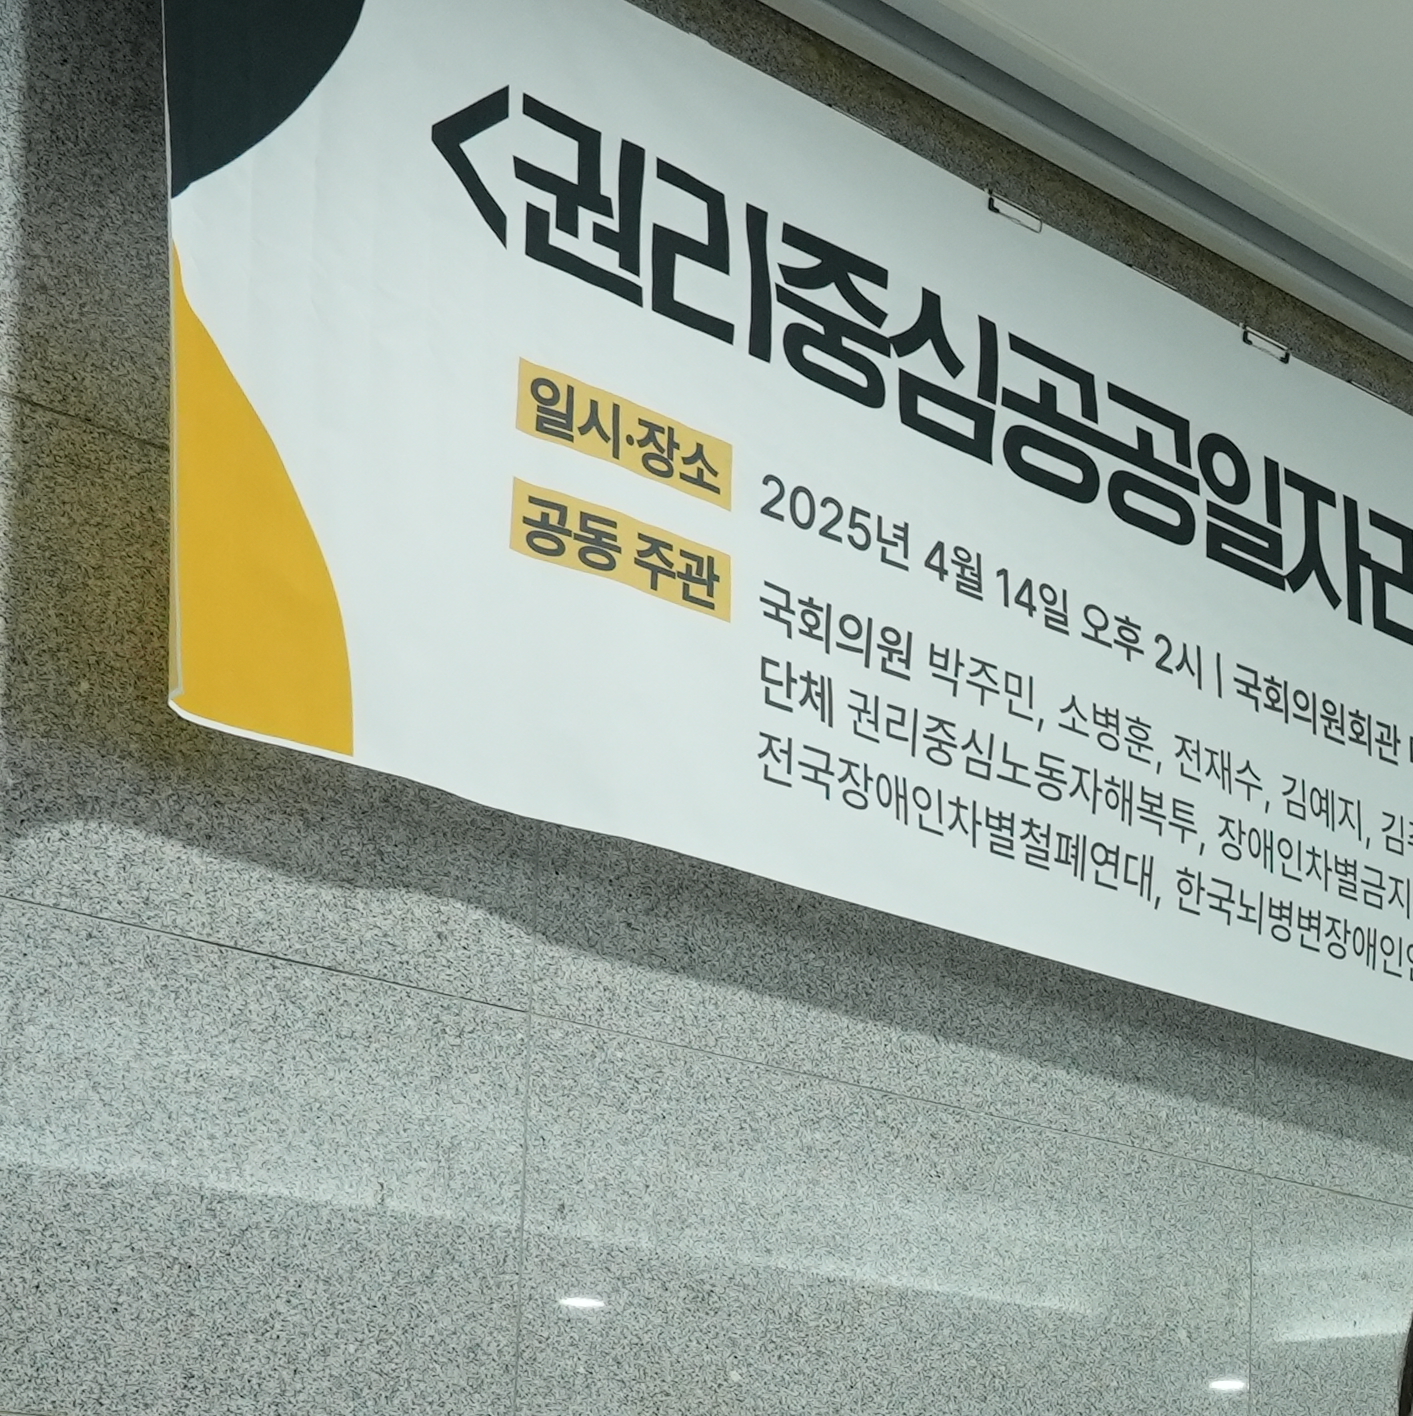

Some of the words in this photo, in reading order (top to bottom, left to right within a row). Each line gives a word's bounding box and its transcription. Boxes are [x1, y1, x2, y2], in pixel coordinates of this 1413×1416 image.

[528, 375, 721, 496] 일시·장소
[522, 494, 622, 572] 공동
[633, 528, 720, 611] 주관
[760, 473, 910, 571] 2025년
[924, 540, 984, 601] 4월
[995, 567, 1070, 636] 14일
[1081, 602, 1145, 662] 오후
[1154, 632, 1203, 691] 2시
[1233, 662, 1401, 767] 국회의원회관
[758, 579, 914, 682] 국회의원
[928, 641, 1045, 733] 박주민,
[1058, 693, 1163, 775] 소병훈,
[1173, 733, 1271, 814] 전재수,
[1281, 773, 1372, 851] 김예지,
[760, 655, 834, 728] 단체
[846, 688, 1205, 857] 권리중심노동자해복투,
[757, 730, 1163, 910] 전국장애인차별철폐연대,
